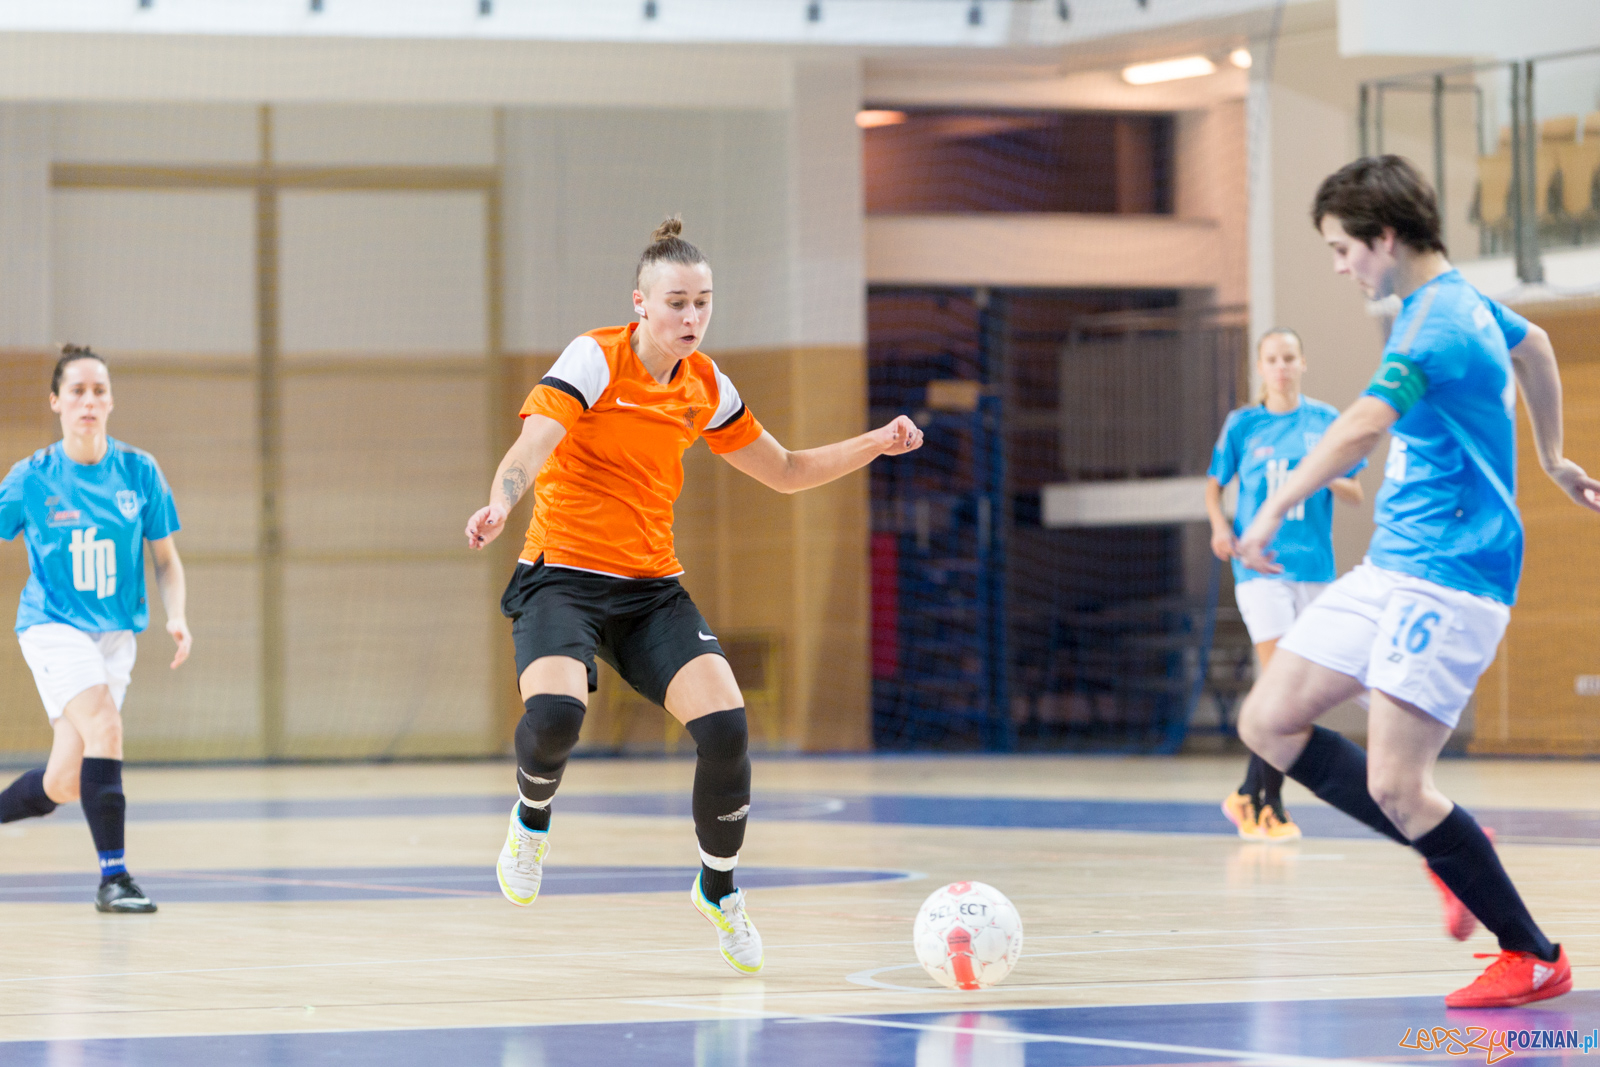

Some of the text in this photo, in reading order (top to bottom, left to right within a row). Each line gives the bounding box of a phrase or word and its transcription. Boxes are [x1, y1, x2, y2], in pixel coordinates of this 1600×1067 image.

[1376, 361, 1410, 390] C
[1392, 601, 1442, 654] 16
[929, 903, 988, 922] SELECT
